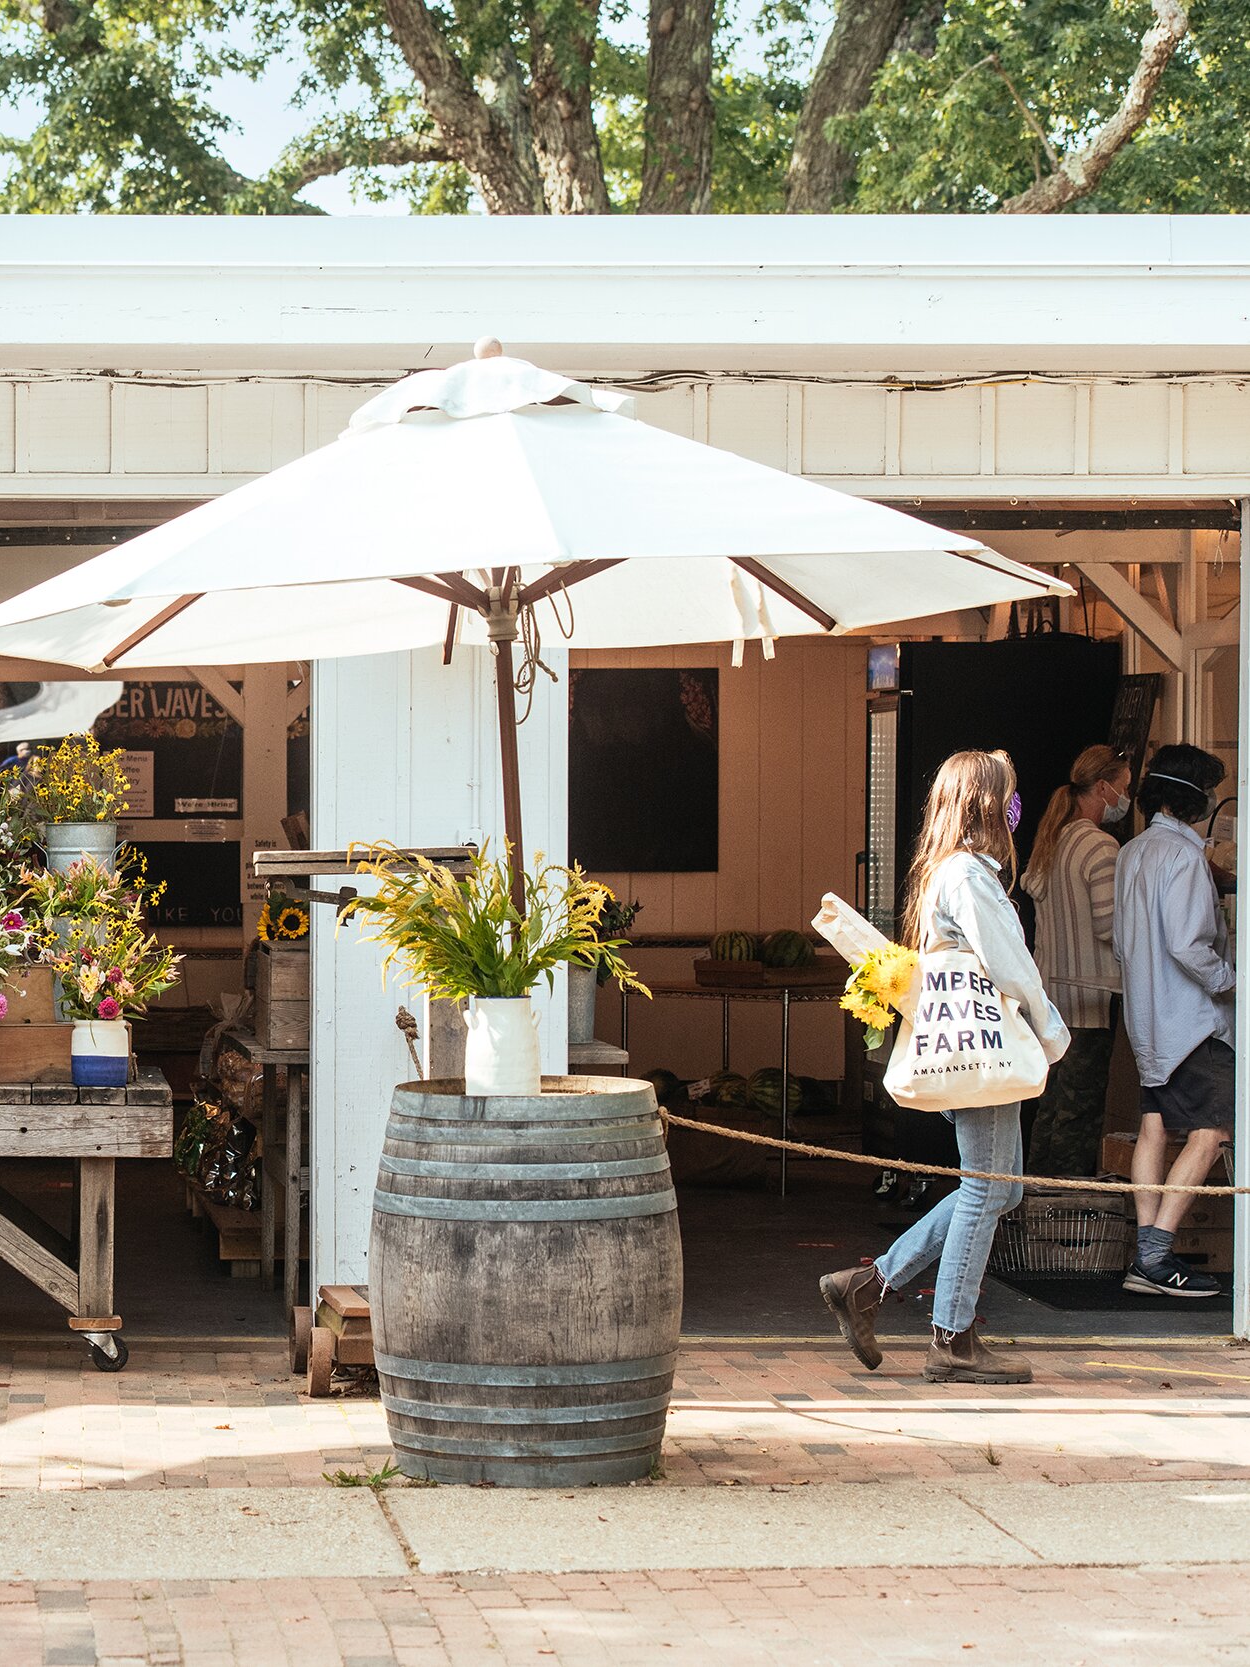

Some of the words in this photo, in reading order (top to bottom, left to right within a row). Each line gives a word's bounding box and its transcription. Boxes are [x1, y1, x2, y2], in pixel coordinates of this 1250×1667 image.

[255, 840, 270, 848] Safety
[921, 971, 996, 997] MBER
[916, 999, 1002, 1023] WAVES
[916, 1029, 1003, 1056] FARM
[913, 1062, 992, 1076] AMAGANSETT,
[999, 1060, 1013, 1068] NY
[1168, 1272, 1188, 1286] N
